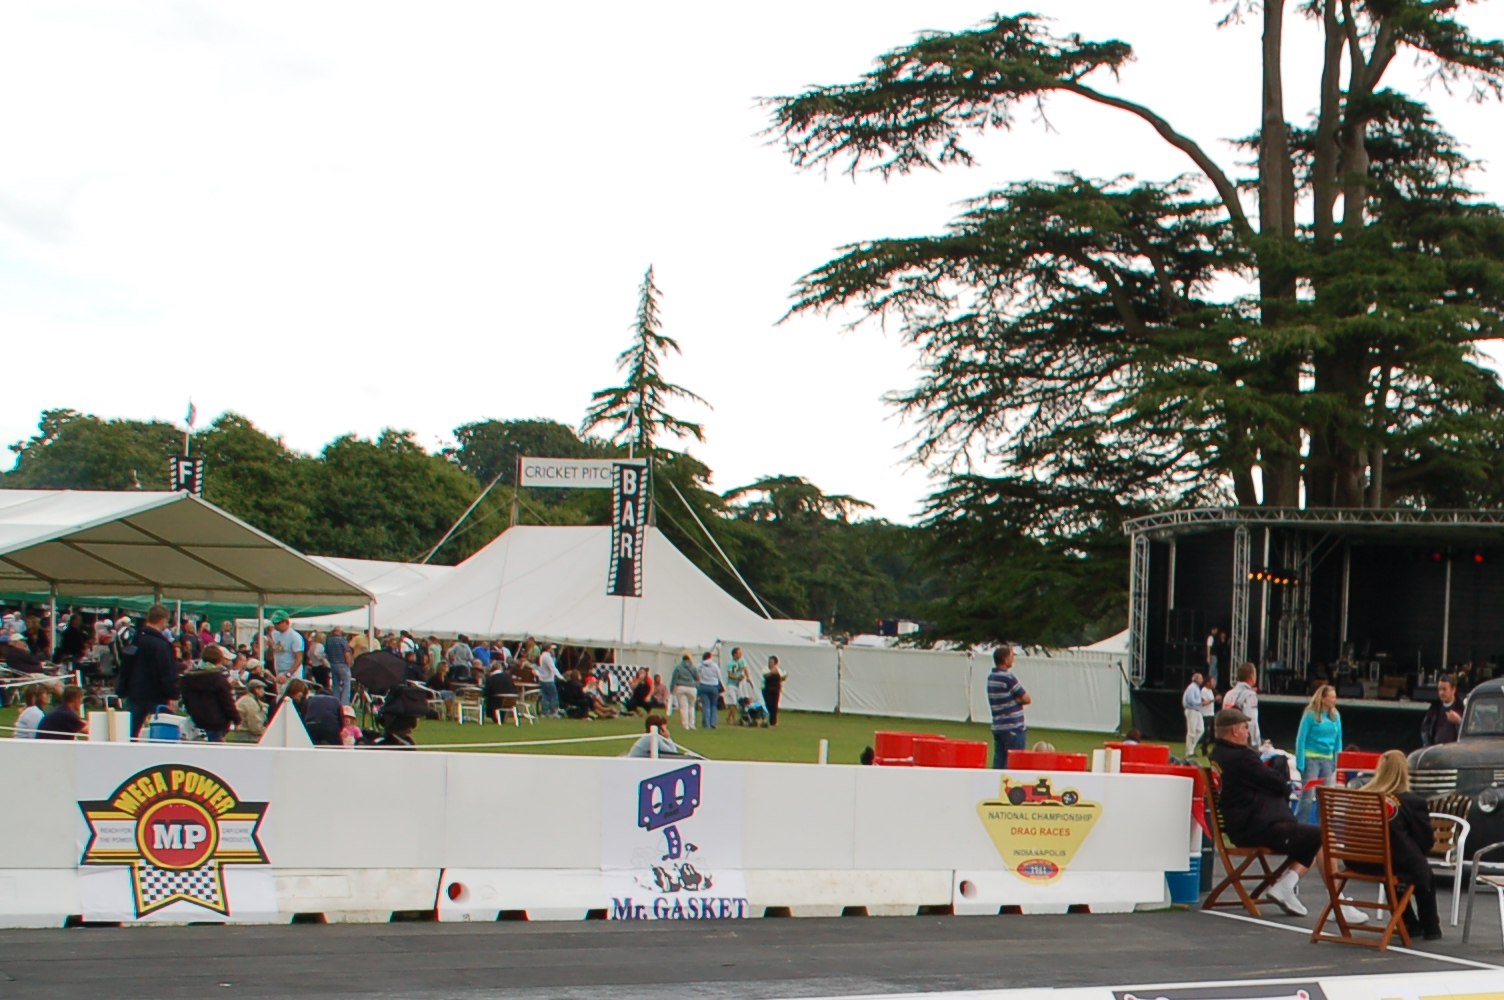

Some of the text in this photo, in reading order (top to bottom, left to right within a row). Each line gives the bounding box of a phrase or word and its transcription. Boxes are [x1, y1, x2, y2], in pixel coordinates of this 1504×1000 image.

[525, 466, 578, 479] CRICKET
[620, 469, 637, 559] BAR
[113, 769, 237, 814] MEGA POWER
[988, 811, 1093, 822] NATIONAL CHAMPIONSHIP
[152, 823, 207, 850] MP
[1010, 827, 1071, 837] DRAG RACES
[1013, 849, 1067, 858] INDIANAPOLIS
[653, 896, 749, 920] GASKET
